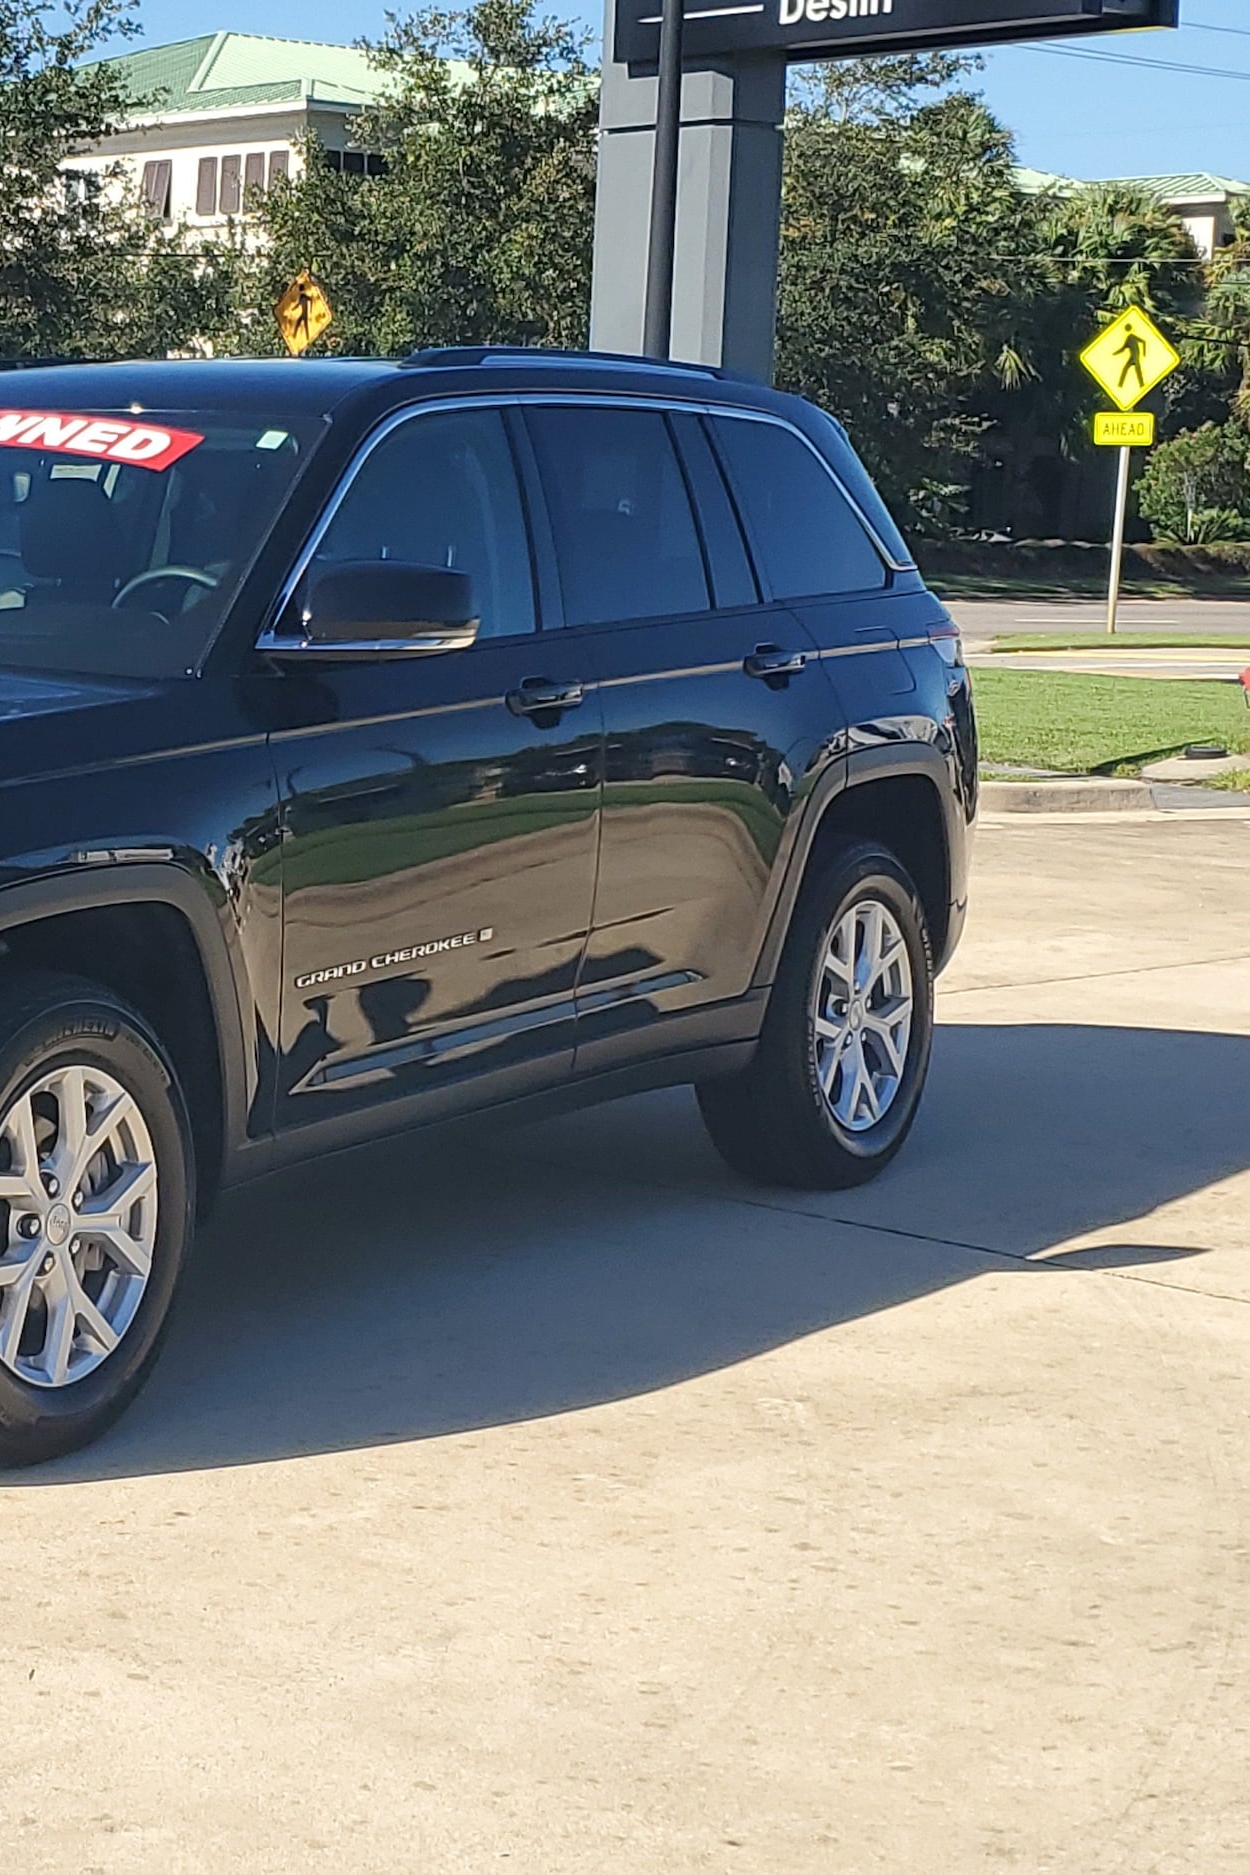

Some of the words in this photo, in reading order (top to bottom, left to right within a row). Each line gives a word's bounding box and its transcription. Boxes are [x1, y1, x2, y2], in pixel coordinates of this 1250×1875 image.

[1103, 423, 1144, 436] AHEAD
[296, 960, 367, 988] GRAND
[370, 932, 476, 968] CHEROKEE
